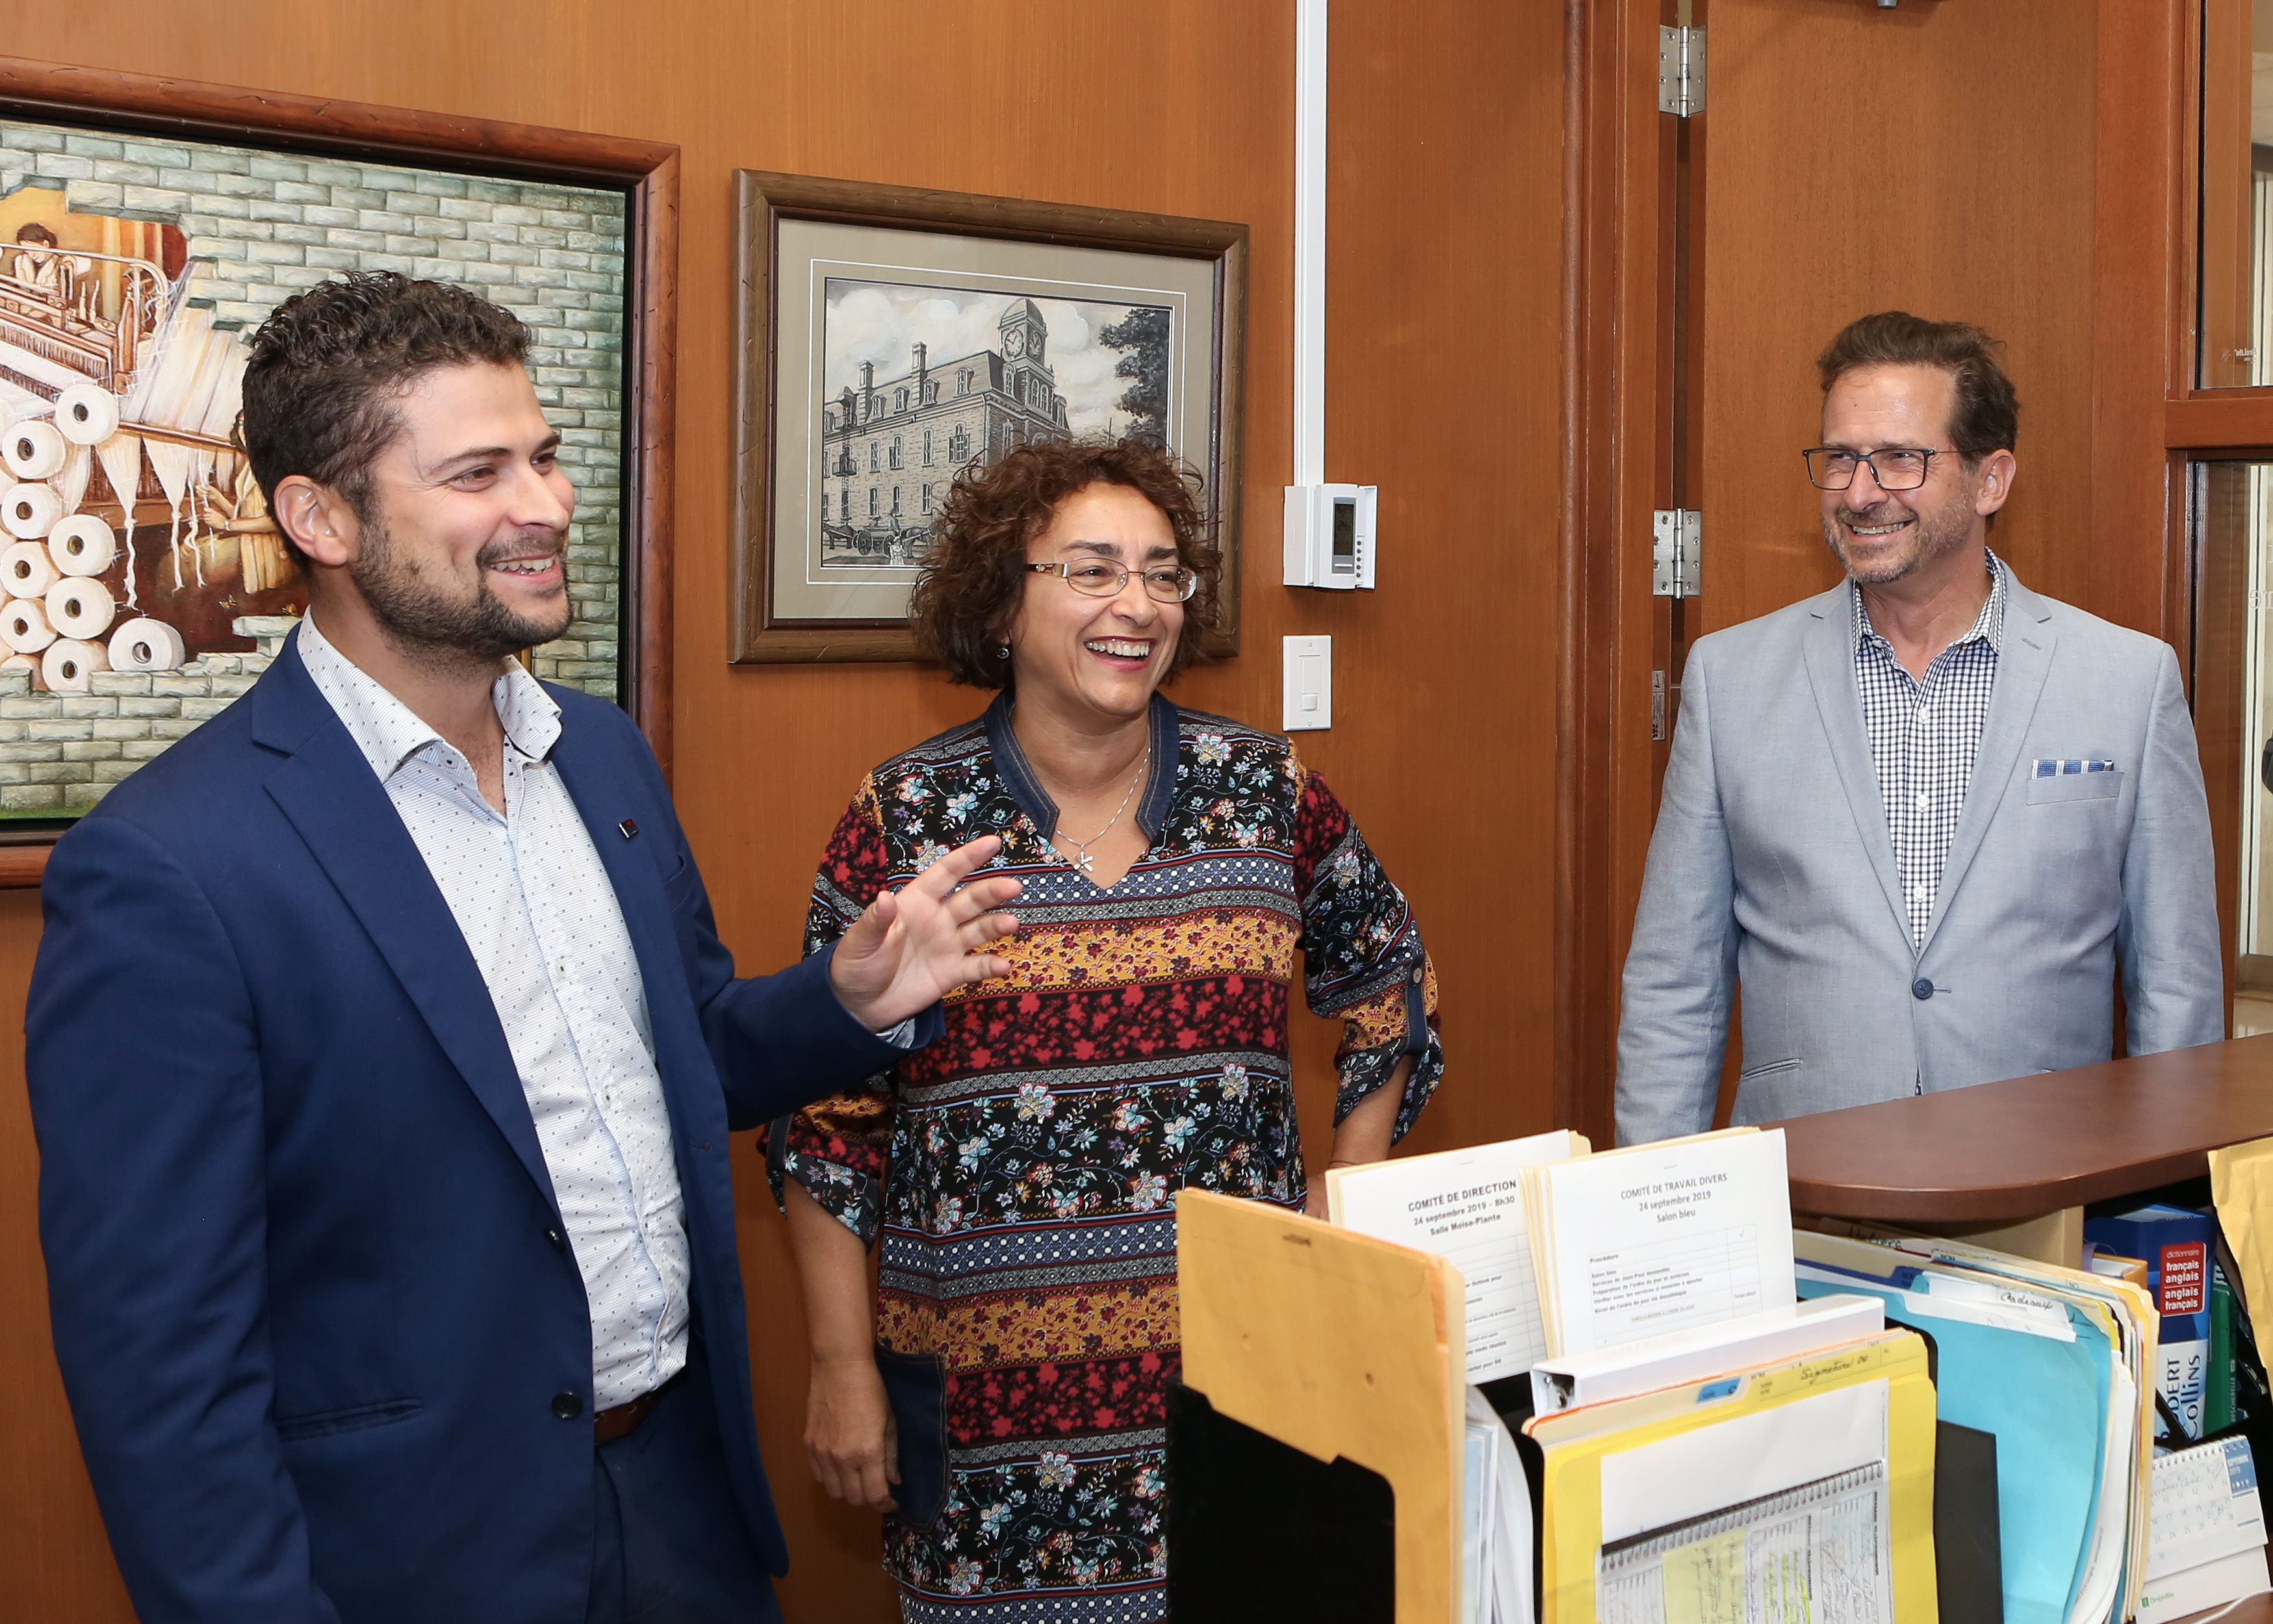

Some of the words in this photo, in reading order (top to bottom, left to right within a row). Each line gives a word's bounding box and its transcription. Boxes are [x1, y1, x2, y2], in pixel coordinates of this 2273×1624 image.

[1620, 1184, 1650, 1200] COMITÉ
[1652, 1185, 1662, 1194] DE
[1665, 1178, 1697, 1191] TRAVAIL
[1699, 1172, 1728, 1185] DIVERS
[1408, 1194, 1444, 1212] COMITÉ
[1447, 1192, 1459, 1202] DE
[1461, 1179, 1517, 1200] DIRECTION
[1639, 1202, 1648, 1211] 24
[1650, 1195, 1691, 1209] septembre
[1693, 1190, 1712, 1202] 2019
[1426, 1209, 1465, 1222] septembre
[1467, 1202, 1487, 1213] 2019
[1657, 1213, 1677, 1223] Salon
[1679, 1209, 1696, 1218] bleu
[2166, 1249, 2200, 1259] dictionnaire
[2166, 1260, 2200, 1272] français
[2165, 1271, 2200, 1285] anglais
[2164, 1285, 2199, 1300] anglais
[2165, 1298, 2198, 1311] français
